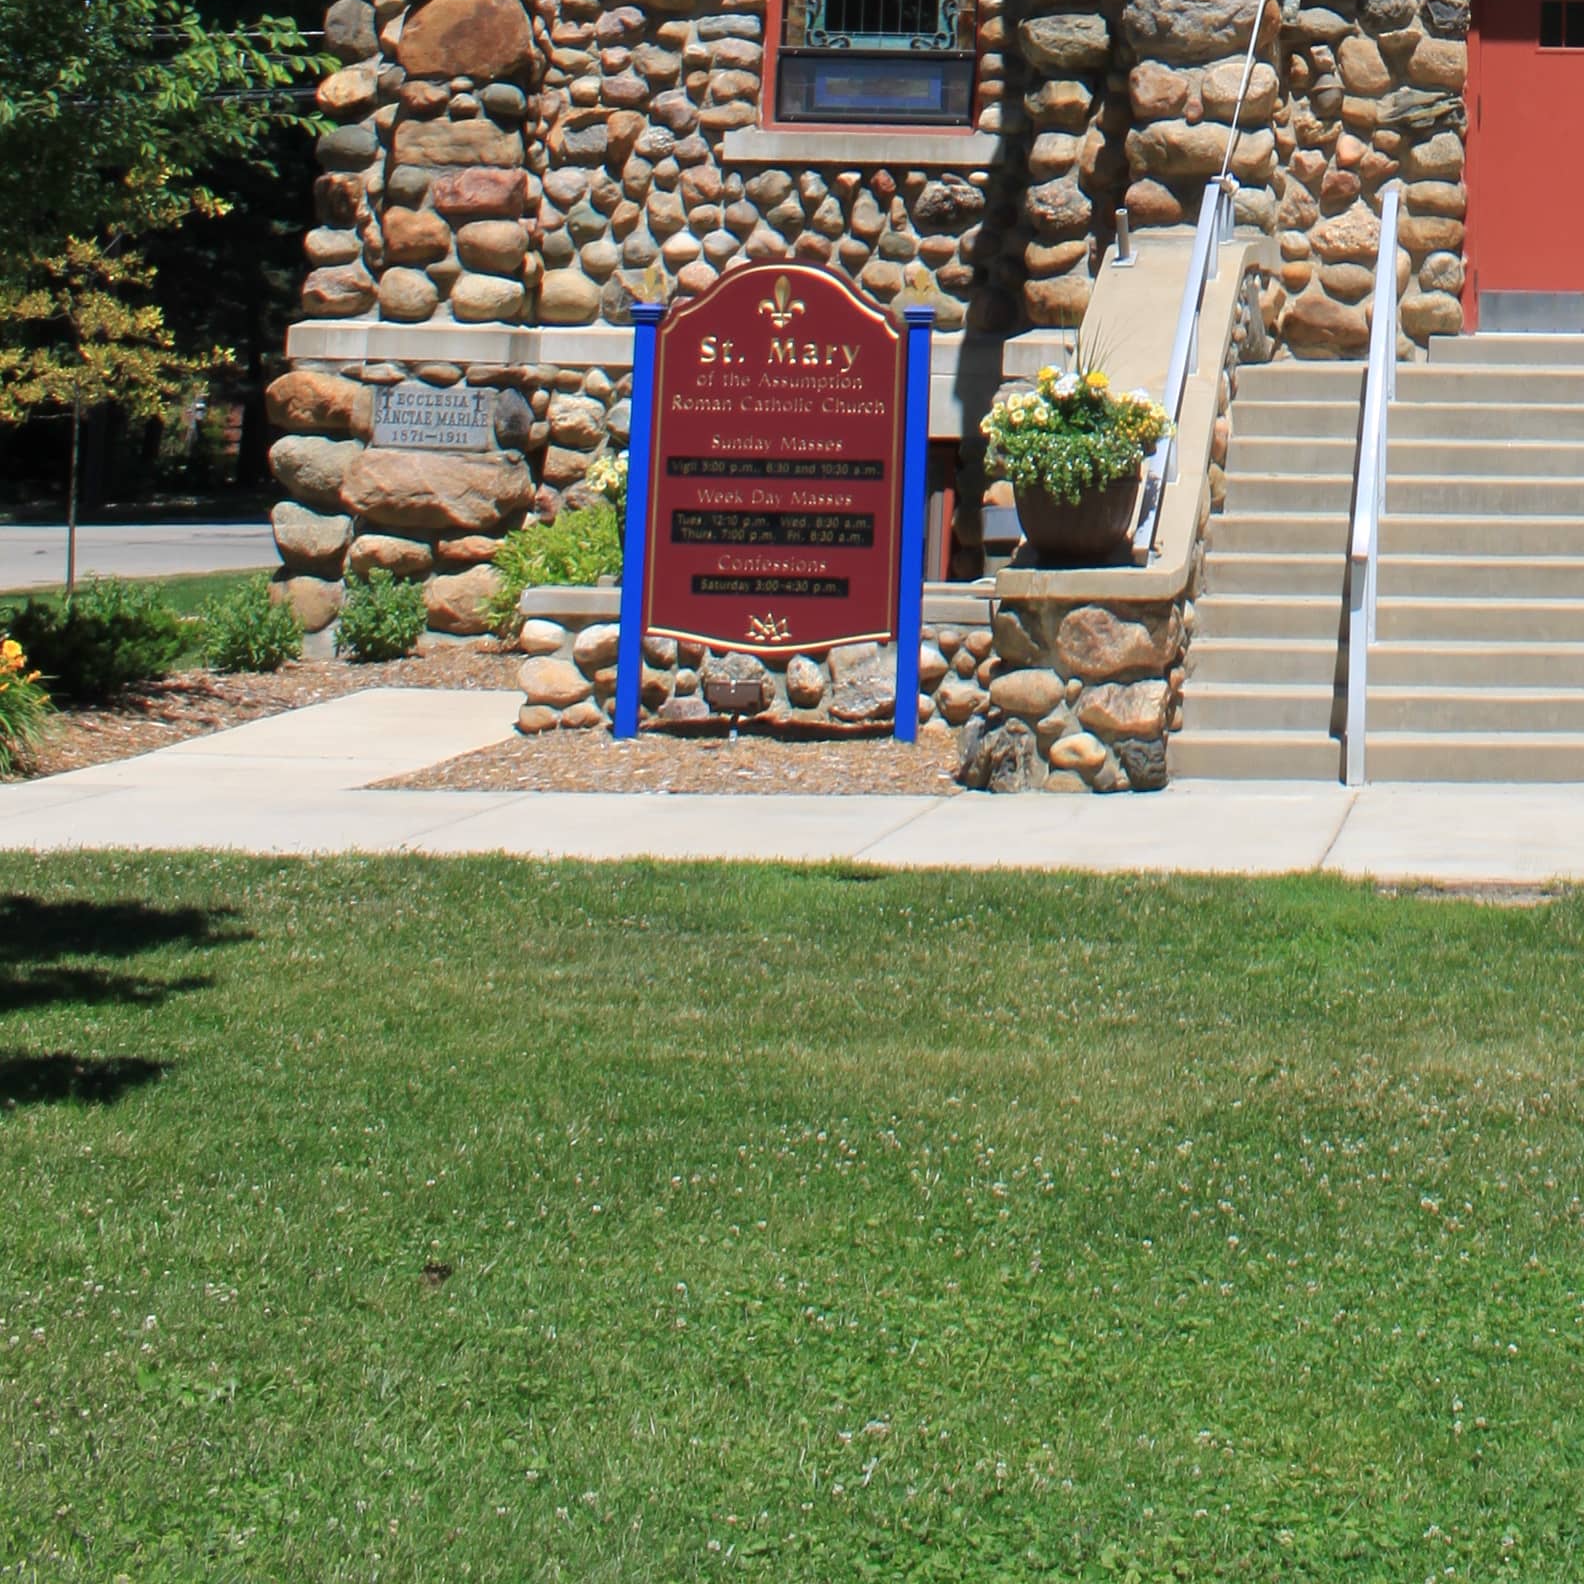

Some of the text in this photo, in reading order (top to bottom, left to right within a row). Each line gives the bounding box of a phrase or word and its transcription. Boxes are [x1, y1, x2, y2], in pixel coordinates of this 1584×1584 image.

[700, 335, 861, 373] St. Mary
[696, 371, 863, 392] of the Assumption
[397, 393, 469, 408] ECCLESIA
[671, 394, 886, 414] Roman Catholic Church
[375, 410, 488, 427] SANCTAE MARIAE
[712, 434, 843, 453] Sunday Masses
[697, 489, 852, 508] Week Day Masses
[718, 554, 828, 573] Confessions
